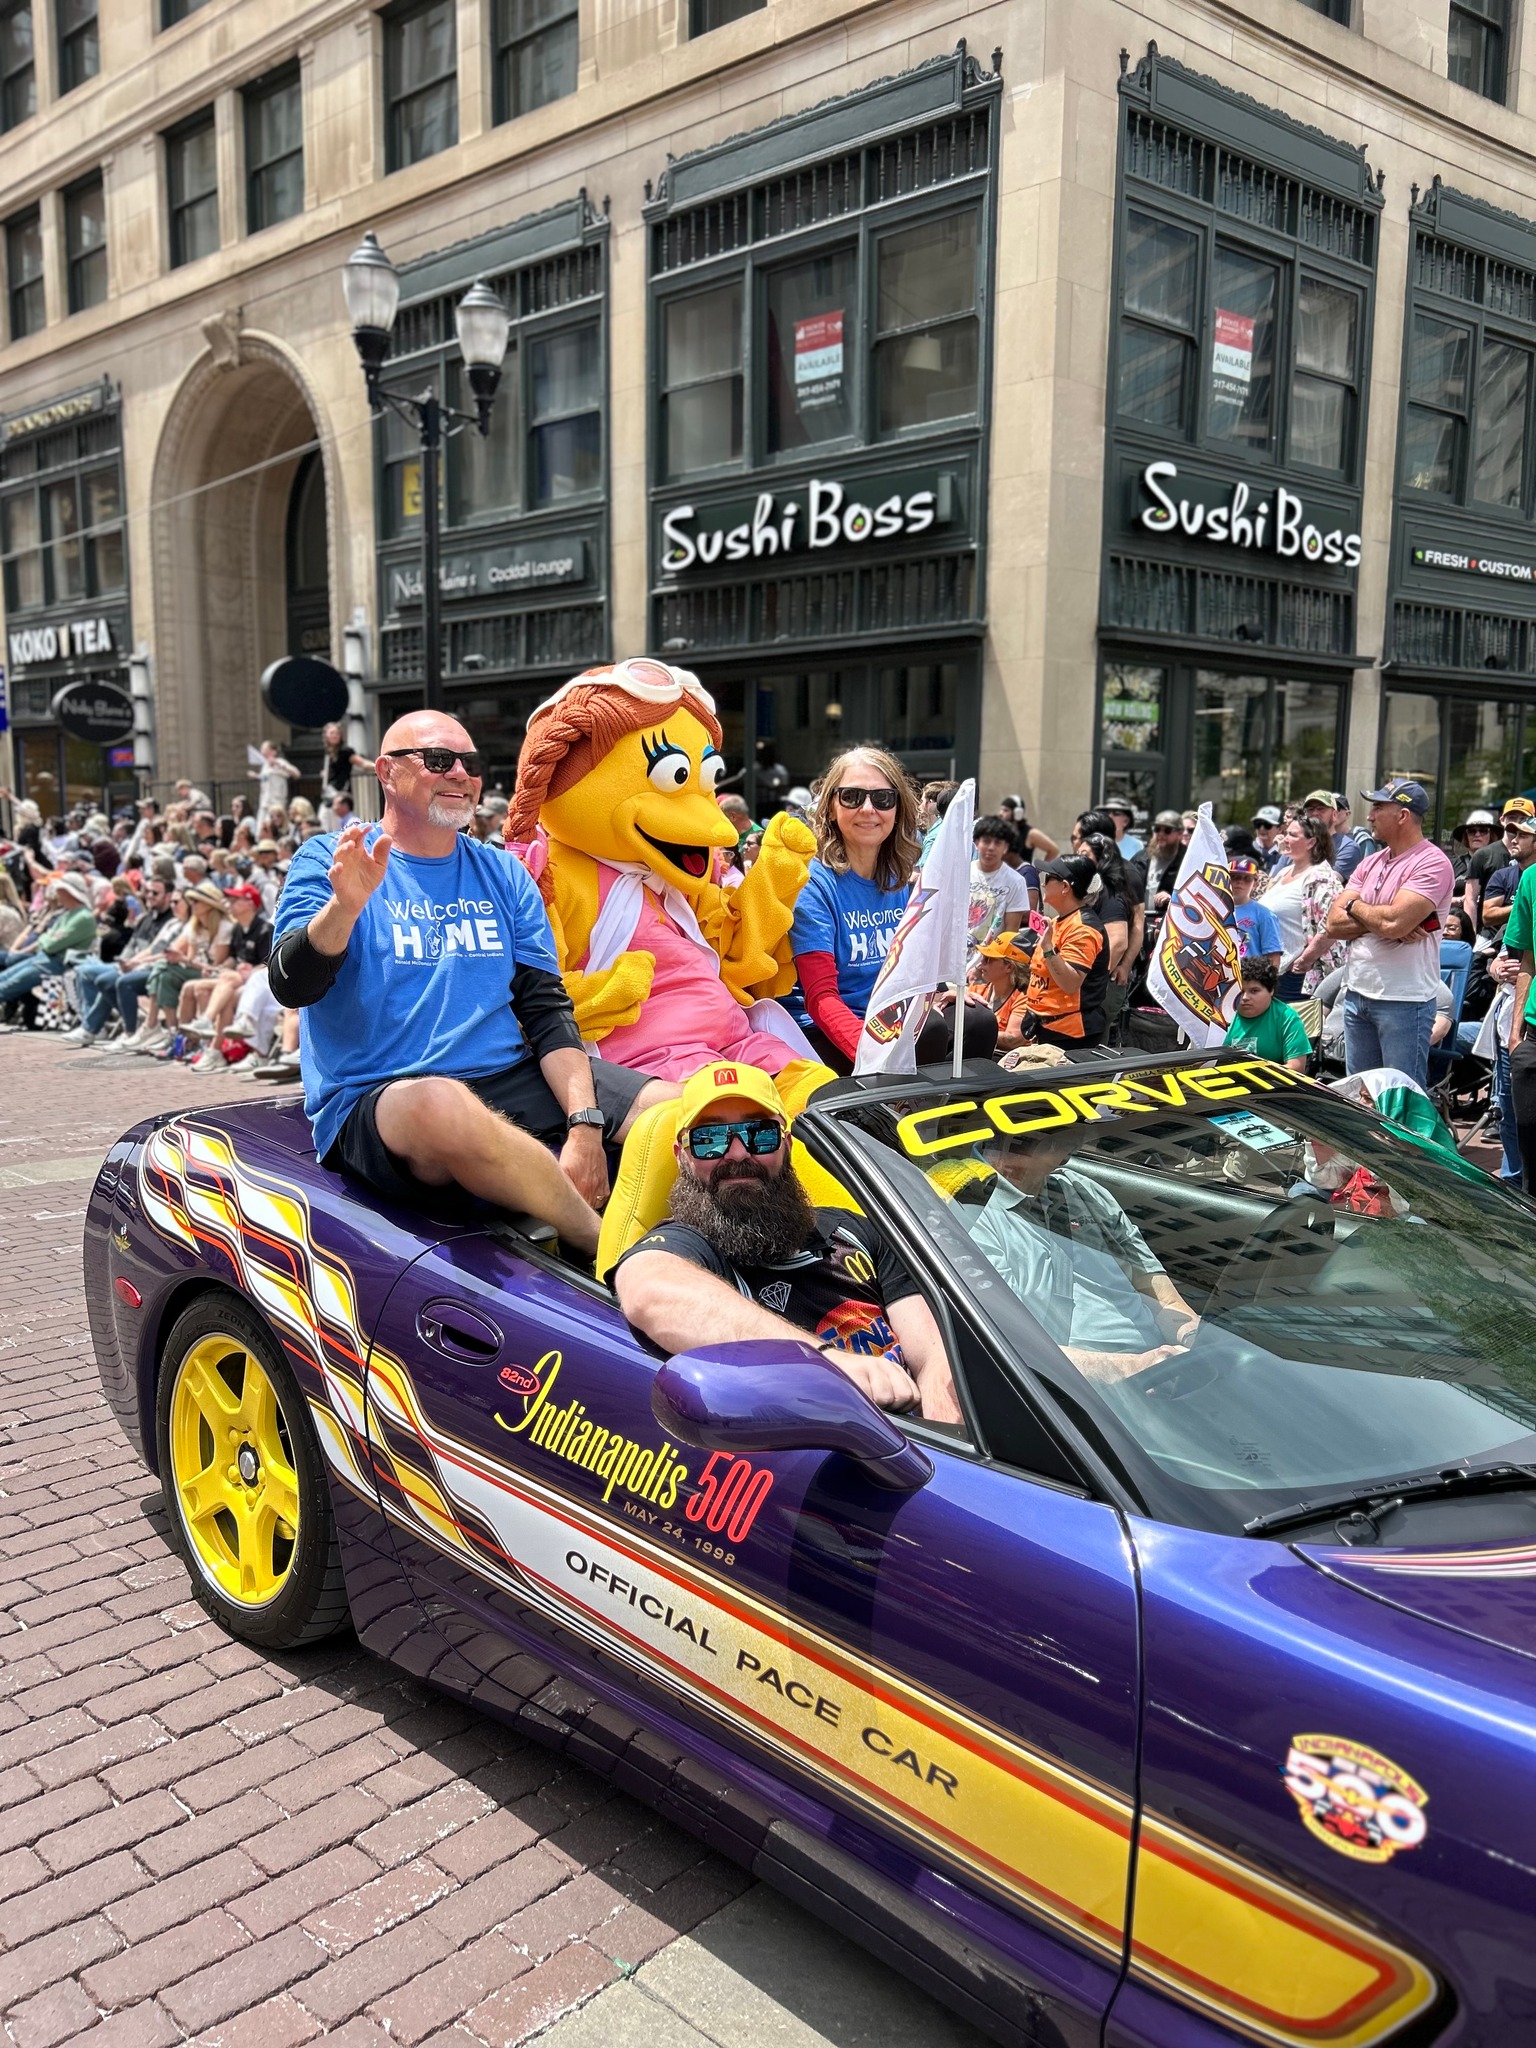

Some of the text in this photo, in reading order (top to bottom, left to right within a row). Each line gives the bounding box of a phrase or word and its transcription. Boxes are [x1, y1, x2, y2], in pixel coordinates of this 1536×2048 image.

[1215, 352, 1250, 371] AVAILABLE
[661, 479, 935, 571] Sushi Boss
[1142, 461, 1361, 567] Sushi Boss
[532, 557, 573, 577] Lounge
[1424, 550, 1532, 579] FRESH CUSTOM
[9, 618, 112, 665] KOKO TEA
[384, 898, 494, 920] Welcome
[843, 908, 904, 930] Welcome
[1165, 956, 1185, 989] MAY
[217, 1309, 246, 1330] ZEON
[500, 1366, 533, 1389] 82nd
[494, 1350, 774, 1543] Indianapolis 500
[623, 1501, 736, 1567] MAY 24, 1998
[565, 1550, 960, 1799] OFFICIAL PACE CAR
[1284, 1747, 1427, 1844] 500
